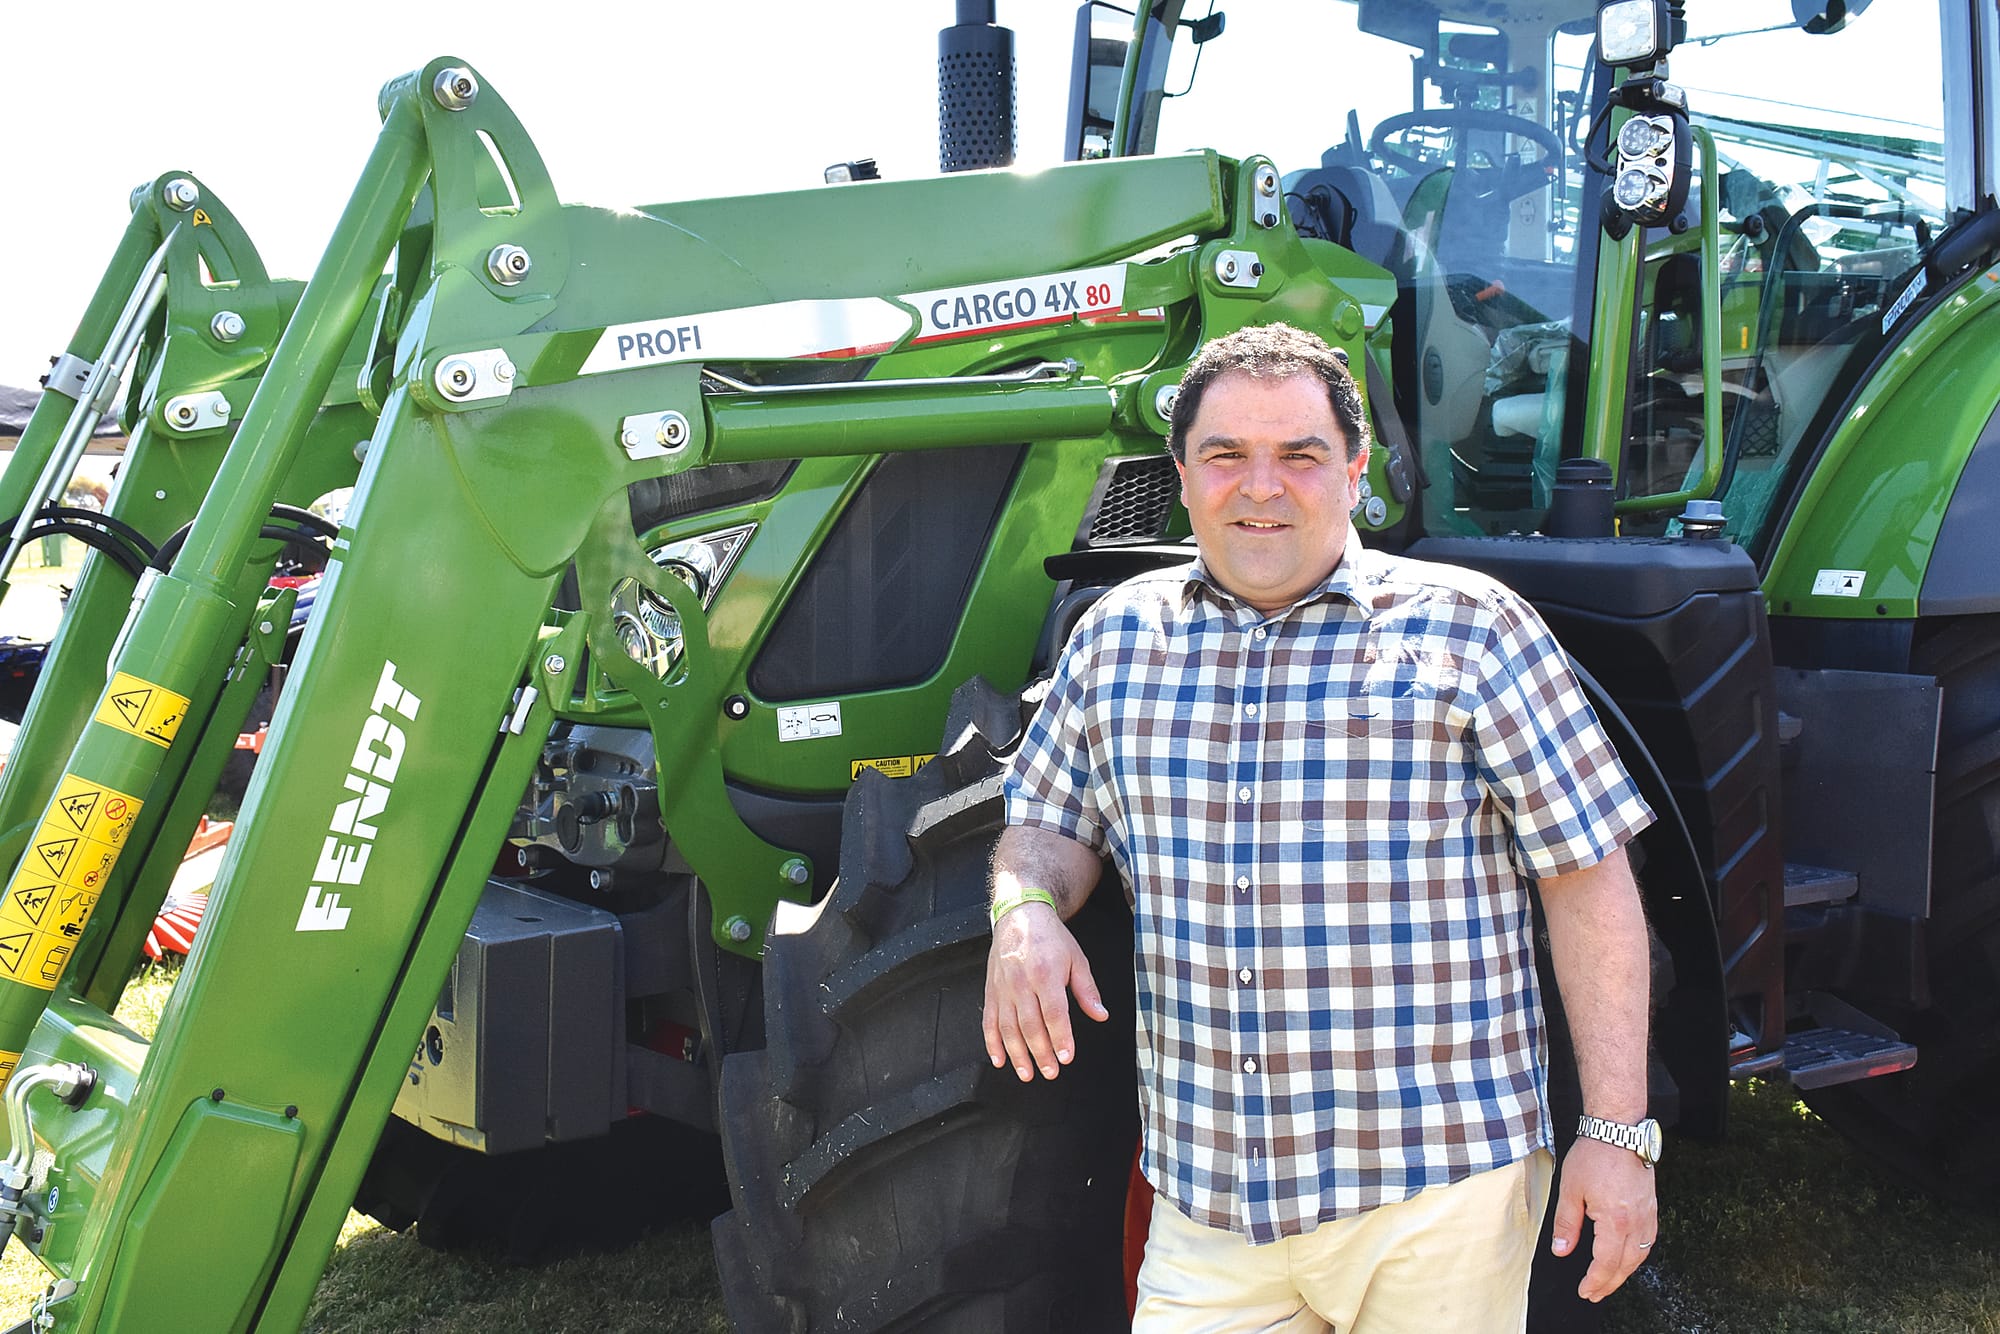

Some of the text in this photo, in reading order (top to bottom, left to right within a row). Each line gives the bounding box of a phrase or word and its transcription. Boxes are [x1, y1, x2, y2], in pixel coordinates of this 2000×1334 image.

[931, 280, 1111, 330] CARGO 4X 80
[617, 325, 702, 361] PROFI
[875, 759, 901, 767] CAUTION
[295, 658, 422, 932] FENDT
